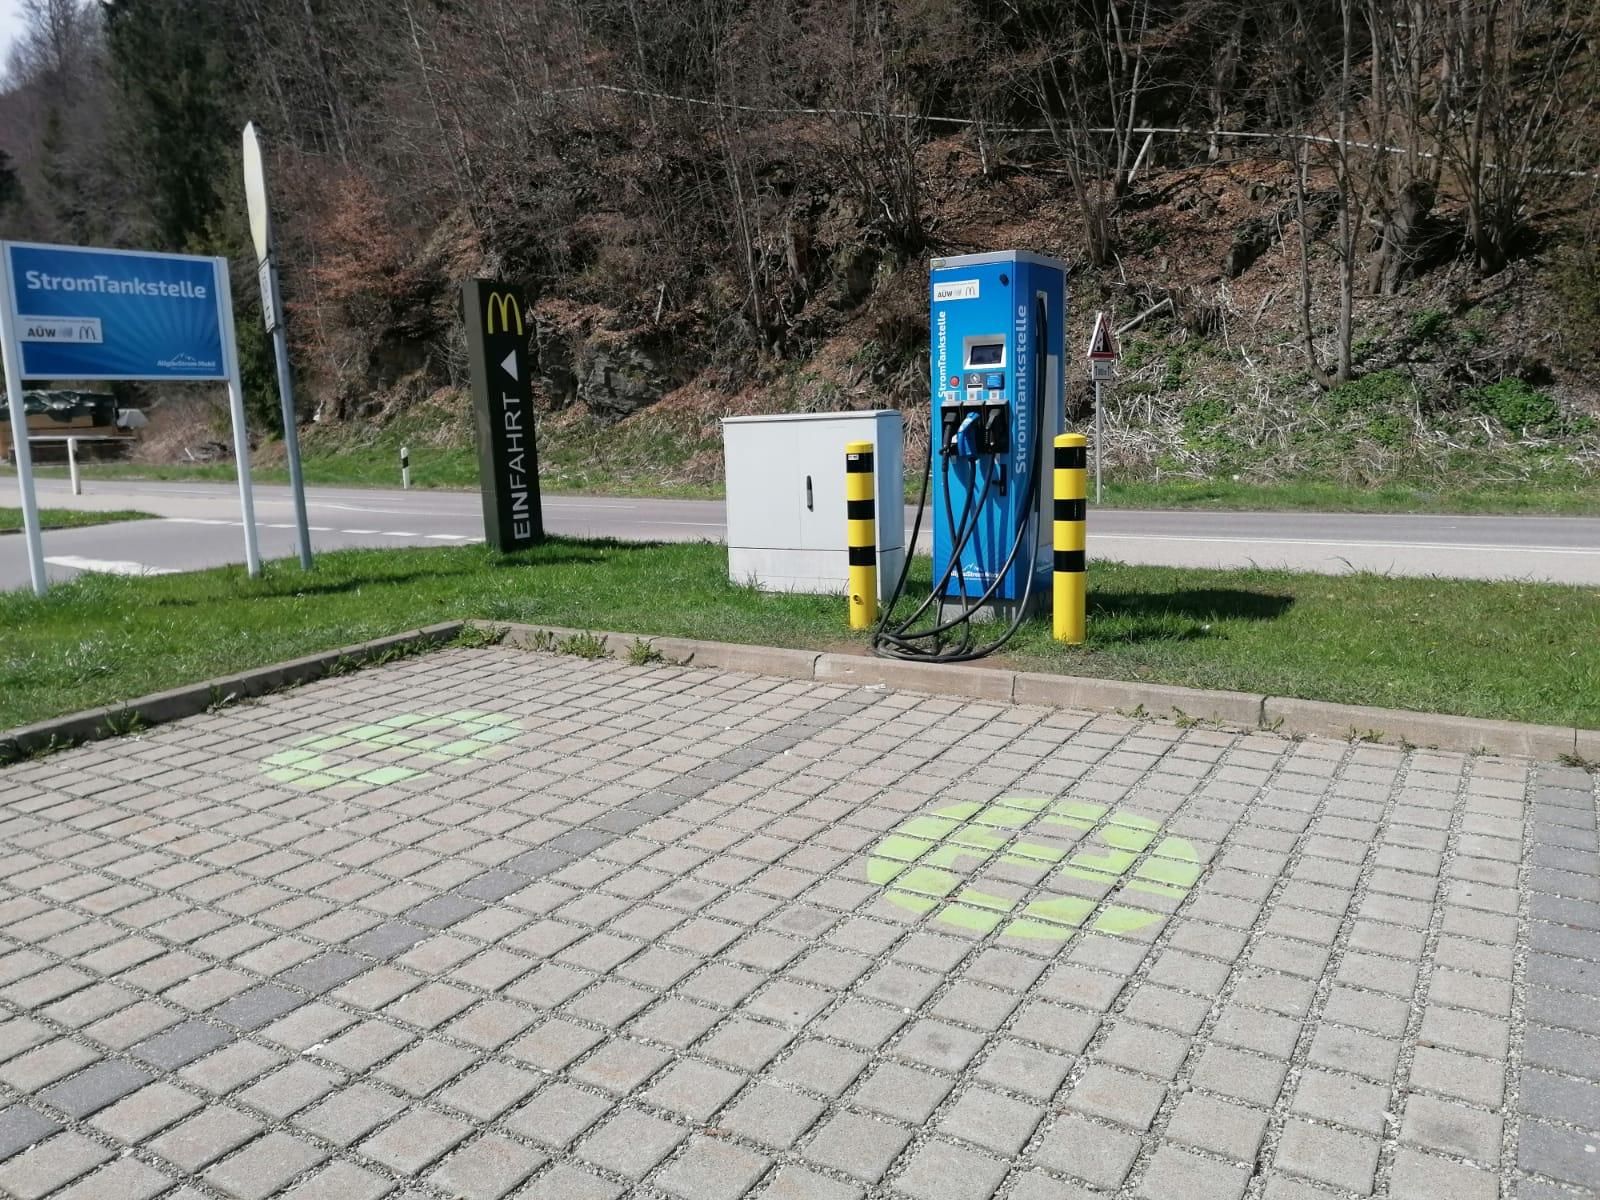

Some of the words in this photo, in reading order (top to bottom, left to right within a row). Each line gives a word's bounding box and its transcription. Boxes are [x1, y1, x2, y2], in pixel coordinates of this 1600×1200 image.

[25, 270, 207, 299] StromTankstelle
[27, 324, 56, 338] AÜW
[937, 311, 947, 398] StromTankstelle
[1015, 305, 1027, 474] StromTankstelle
[503, 392, 531, 539] EINFAHRT
